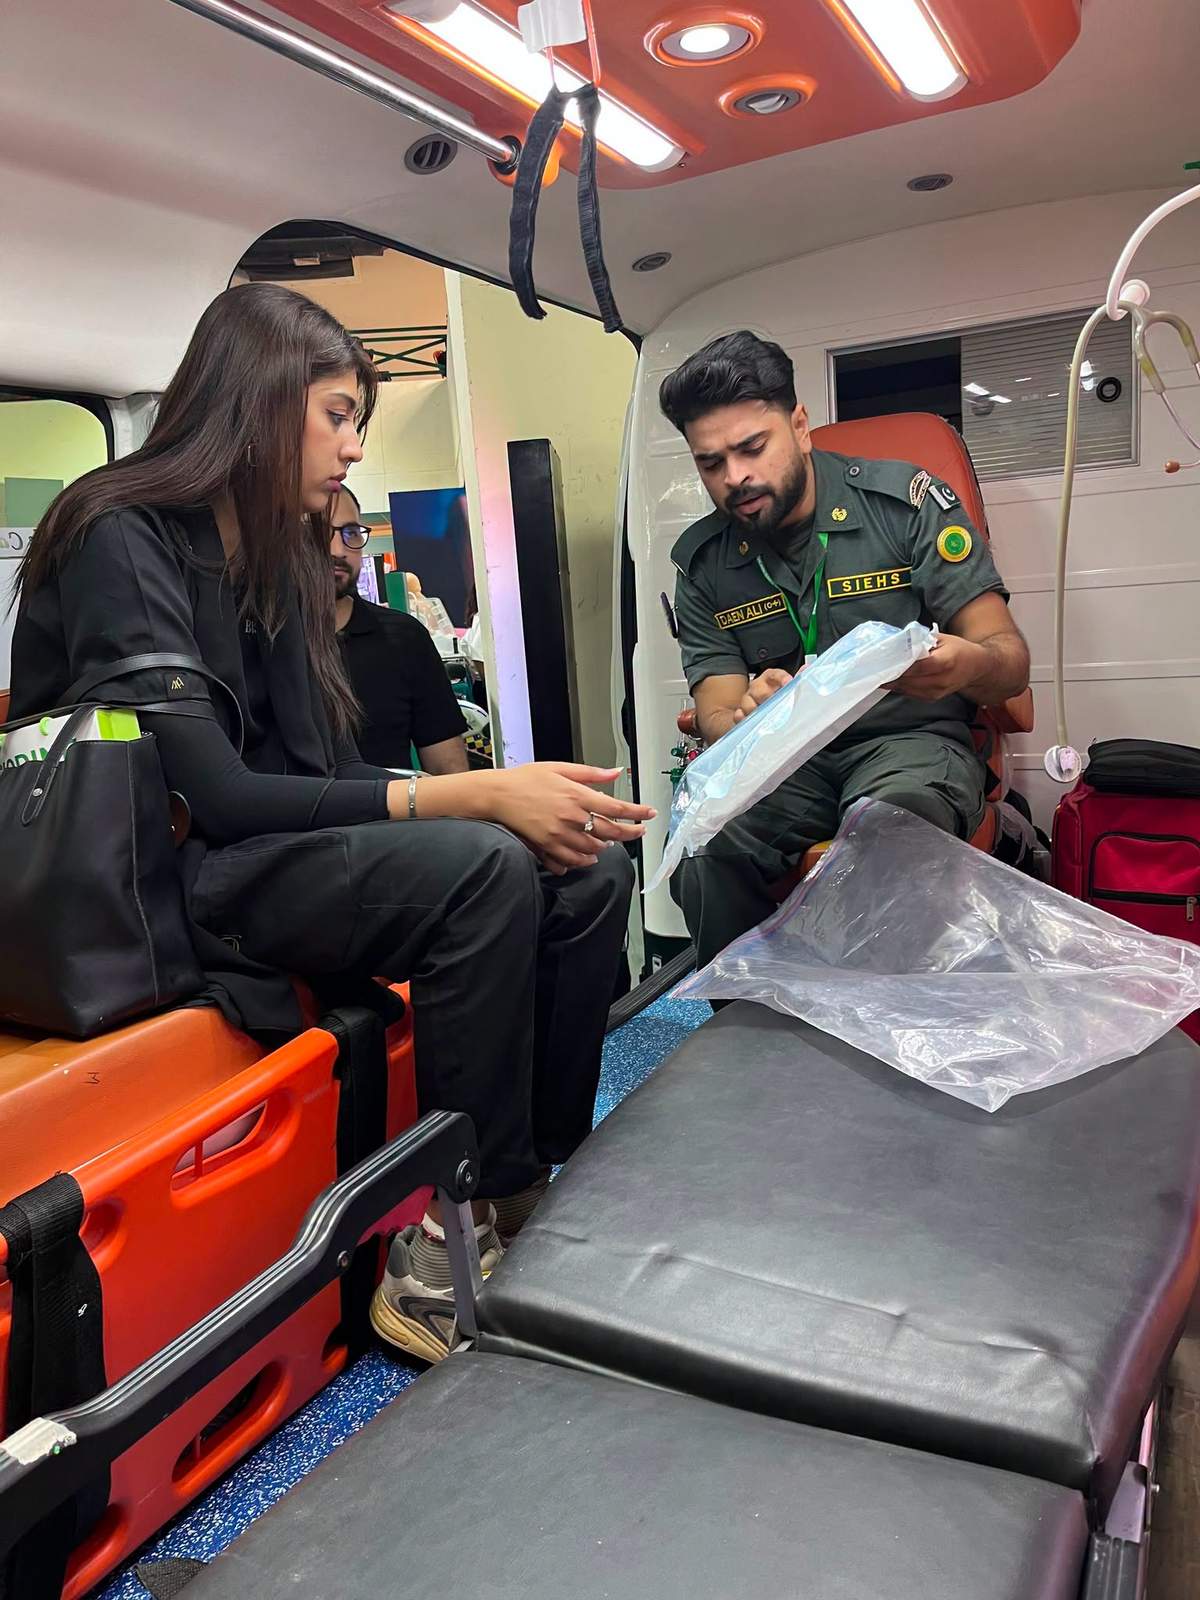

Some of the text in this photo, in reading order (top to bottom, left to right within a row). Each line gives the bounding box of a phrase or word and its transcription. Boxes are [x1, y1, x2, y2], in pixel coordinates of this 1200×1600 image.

[842, 573, 900, 592] SIEHS
[719, 609, 745, 625] DAEN
[746, 604, 763, 619] ALI
